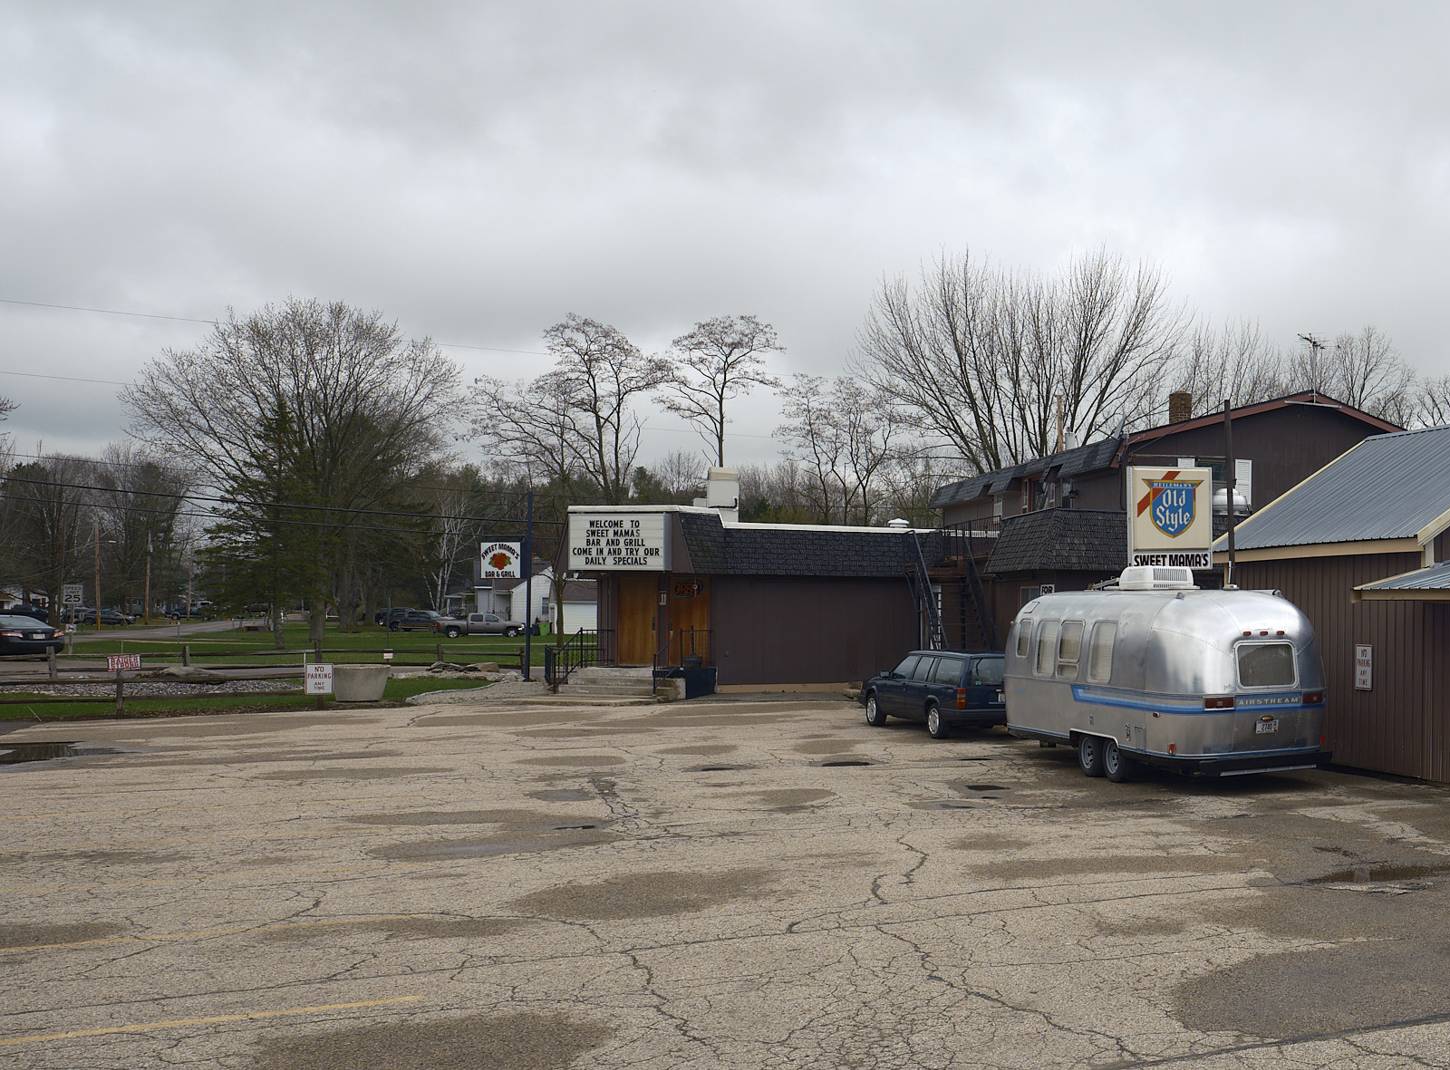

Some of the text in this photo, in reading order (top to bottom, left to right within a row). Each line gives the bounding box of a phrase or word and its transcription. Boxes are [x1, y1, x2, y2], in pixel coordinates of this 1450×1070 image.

[1162, 489, 1186, 508] Old
[1156, 505, 1191, 532] Style
[589, 520, 640, 528] WELCOME TO
[585, 529, 641, 538] SWEET MAMAS
[586, 538, 646, 547] BAR AND GRILL
[481, 543, 497, 560] SWEET
[572, 547, 660, 556] COME IN AND TRY OUR
[584, 557, 648, 566] DAILY SPECIALS
[1134, 553, 1209, 567] SWEET MAMA'S
[1239, 697, 1300, 705] AIRSTREAM
